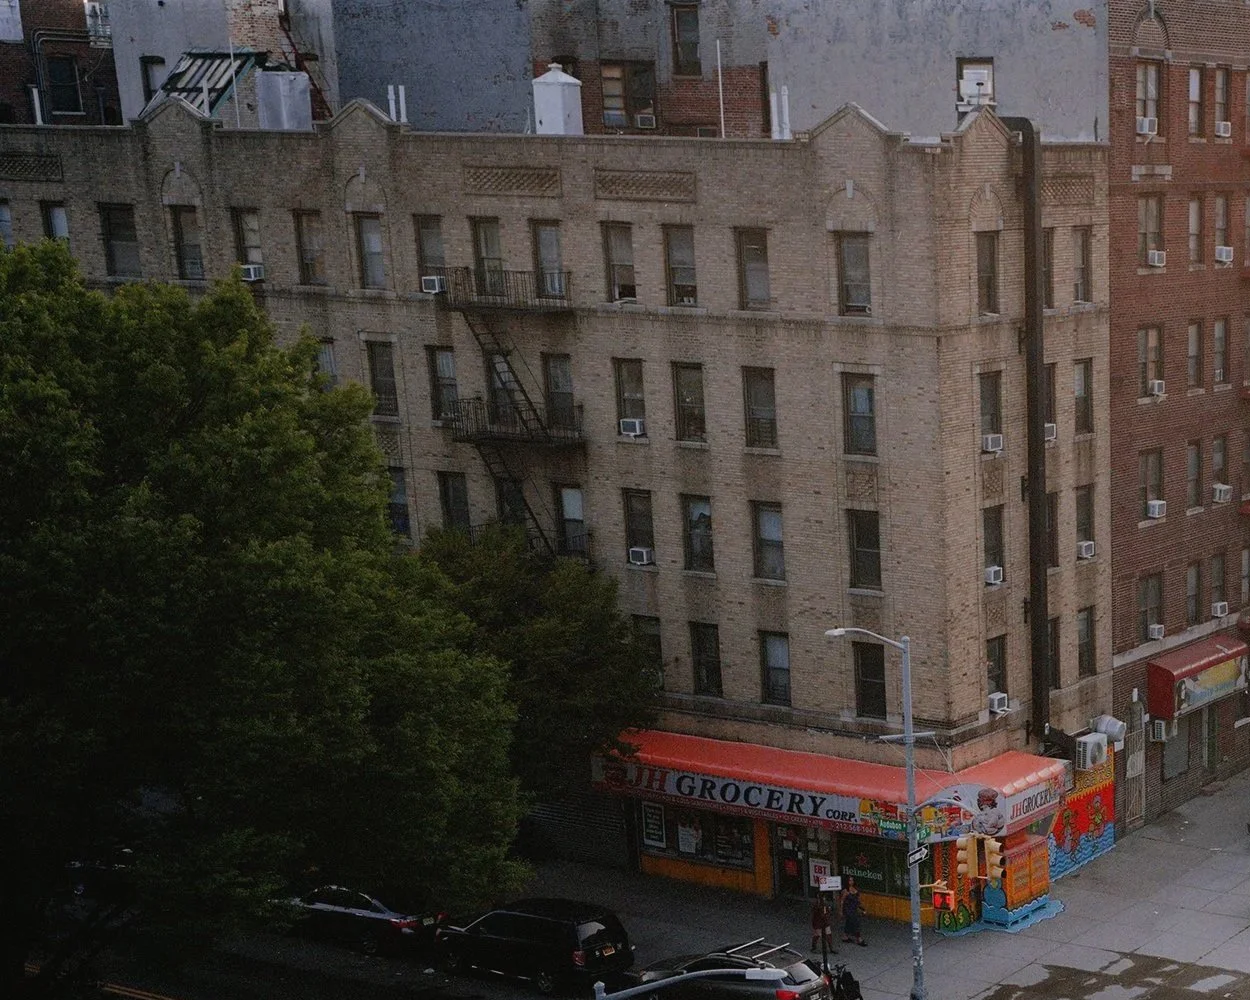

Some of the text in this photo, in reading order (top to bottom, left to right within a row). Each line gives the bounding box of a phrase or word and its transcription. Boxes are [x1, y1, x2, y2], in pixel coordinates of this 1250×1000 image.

[676, 775, 827, 817] GROCERY
[825, 809, 858, 823] CORP.
[1010, 802, 1023, 820] JH
[842, 866, 883, 880] Heineken
